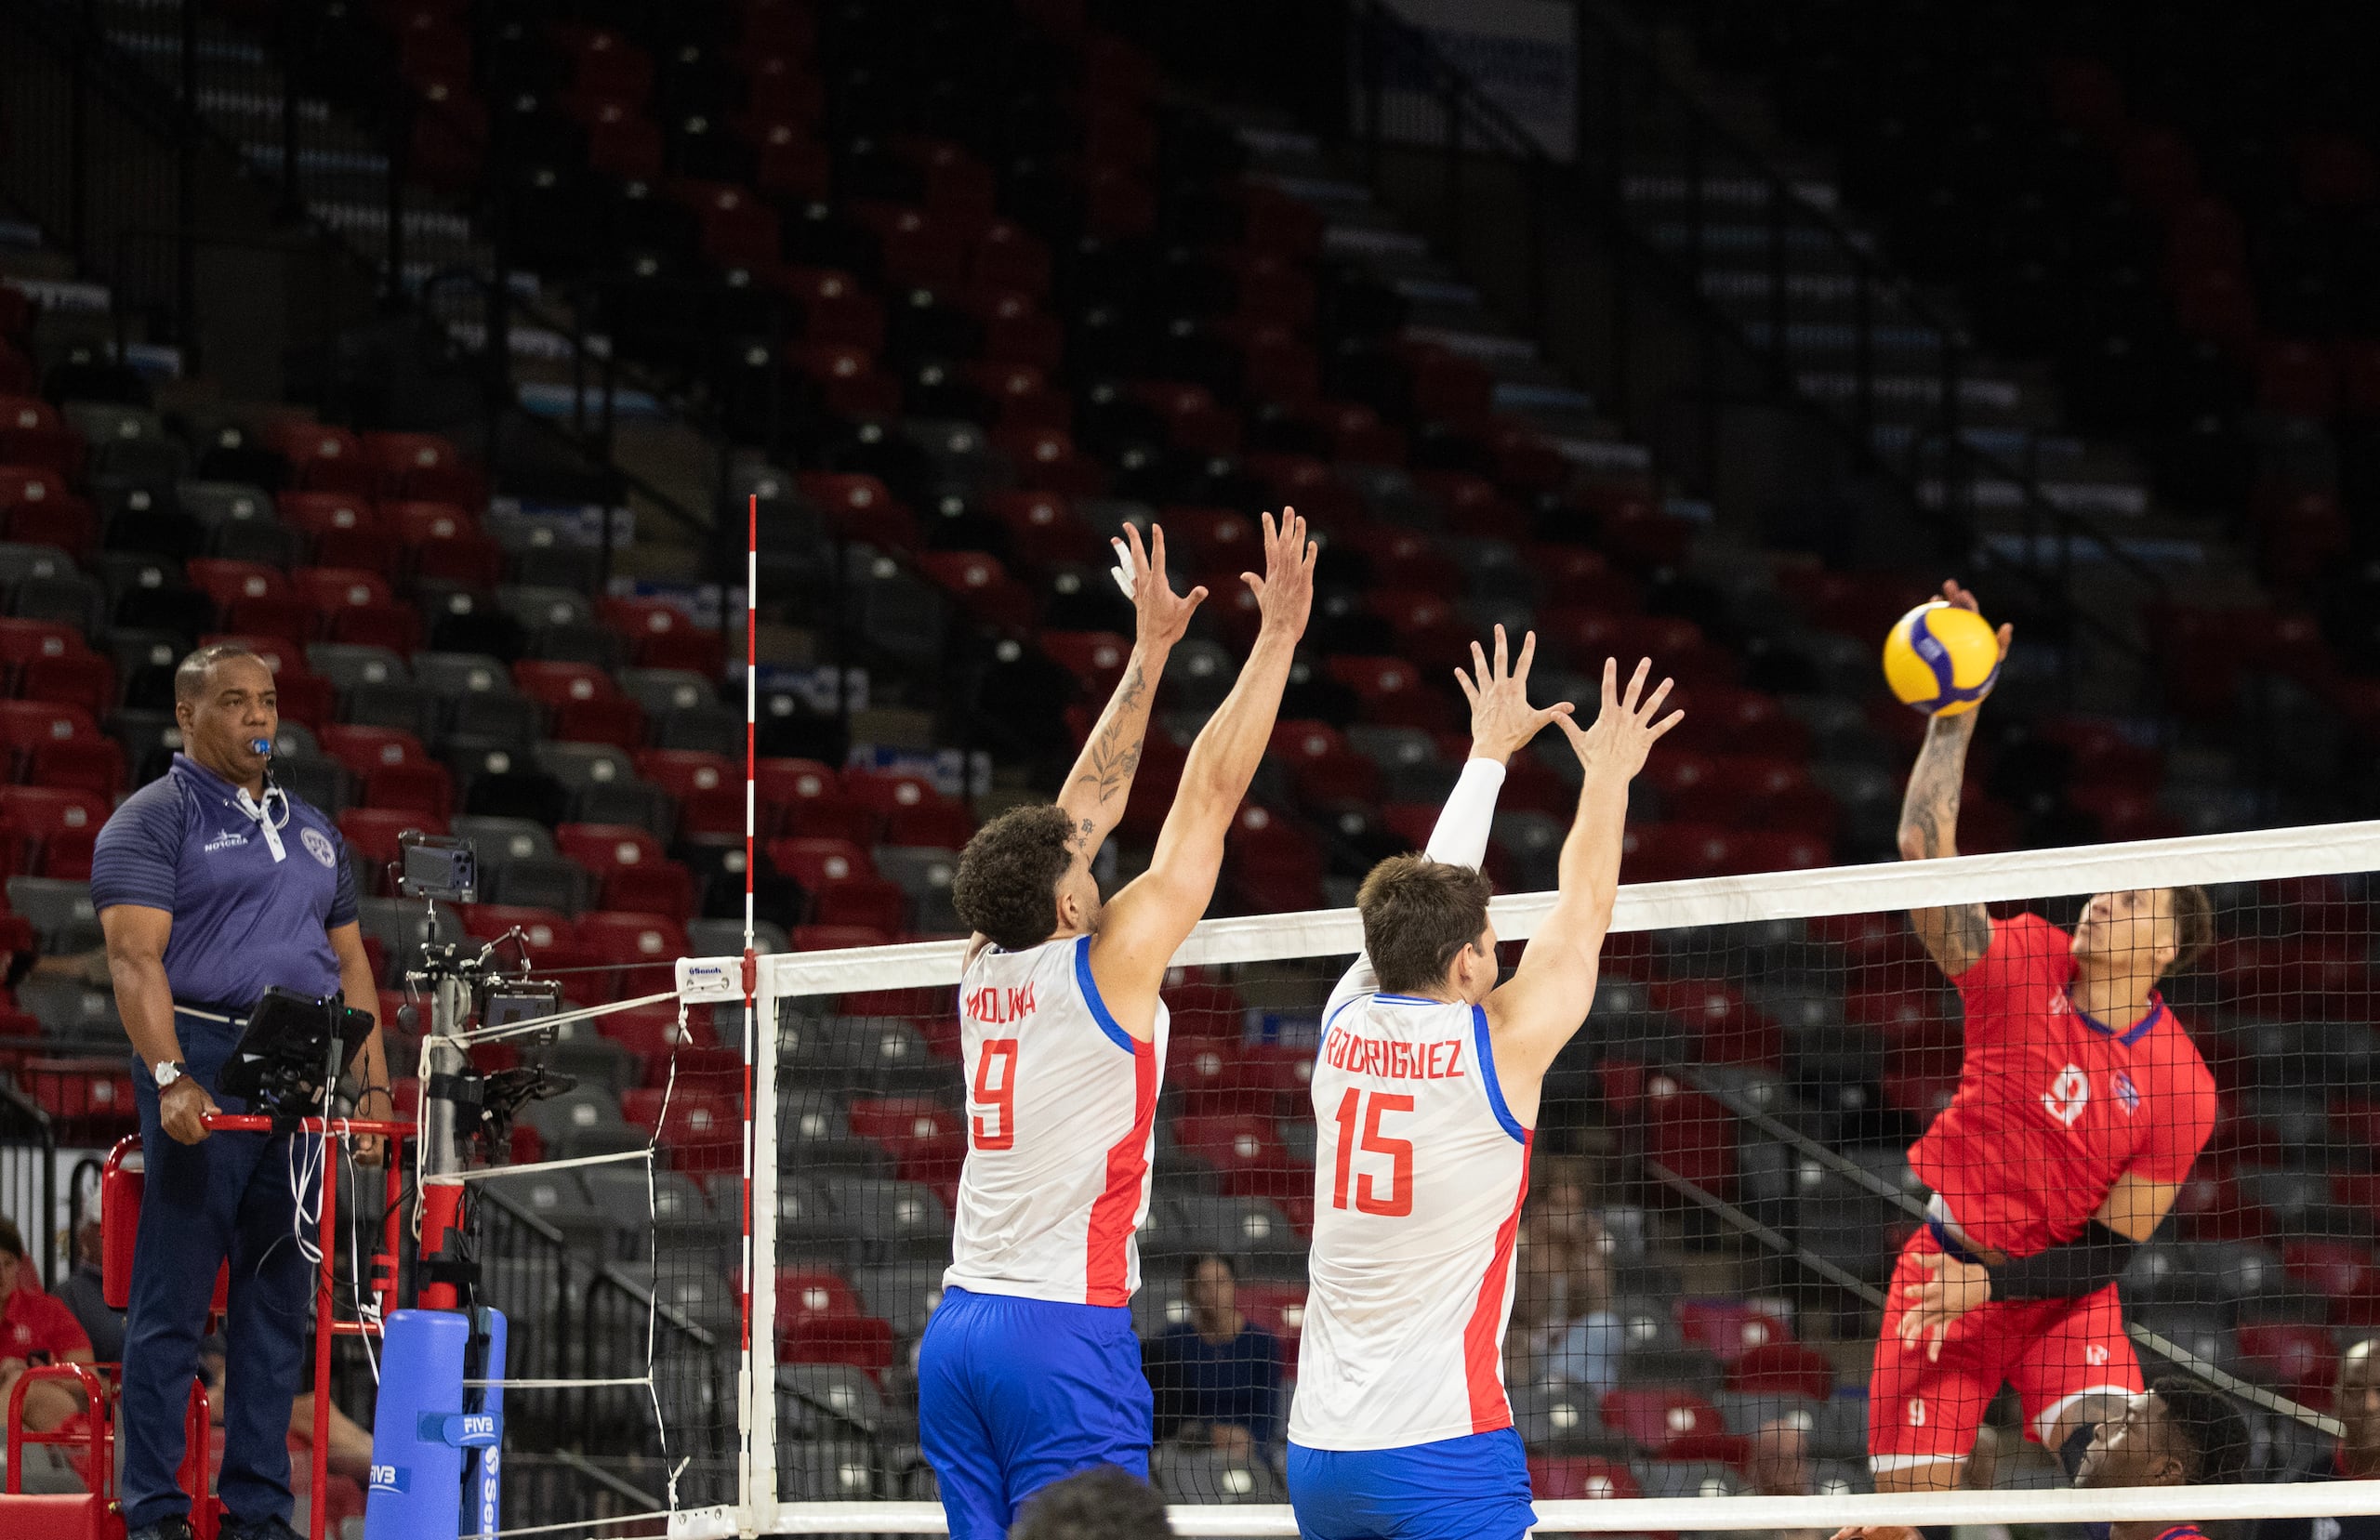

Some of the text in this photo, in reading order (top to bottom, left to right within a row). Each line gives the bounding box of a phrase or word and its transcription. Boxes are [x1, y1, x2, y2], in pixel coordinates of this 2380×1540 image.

[966, 981, 1036, 1024] MOLINA
[1326, 1026, 1464, 1079] RODRIGUEZ
[973, 1039, 1018, 1151] 9
[2040, 1063, 2091, 1127] 9
[1333, 1086, 1414, 1218] 15
[1909, 1398, 1926, 1428] 9
